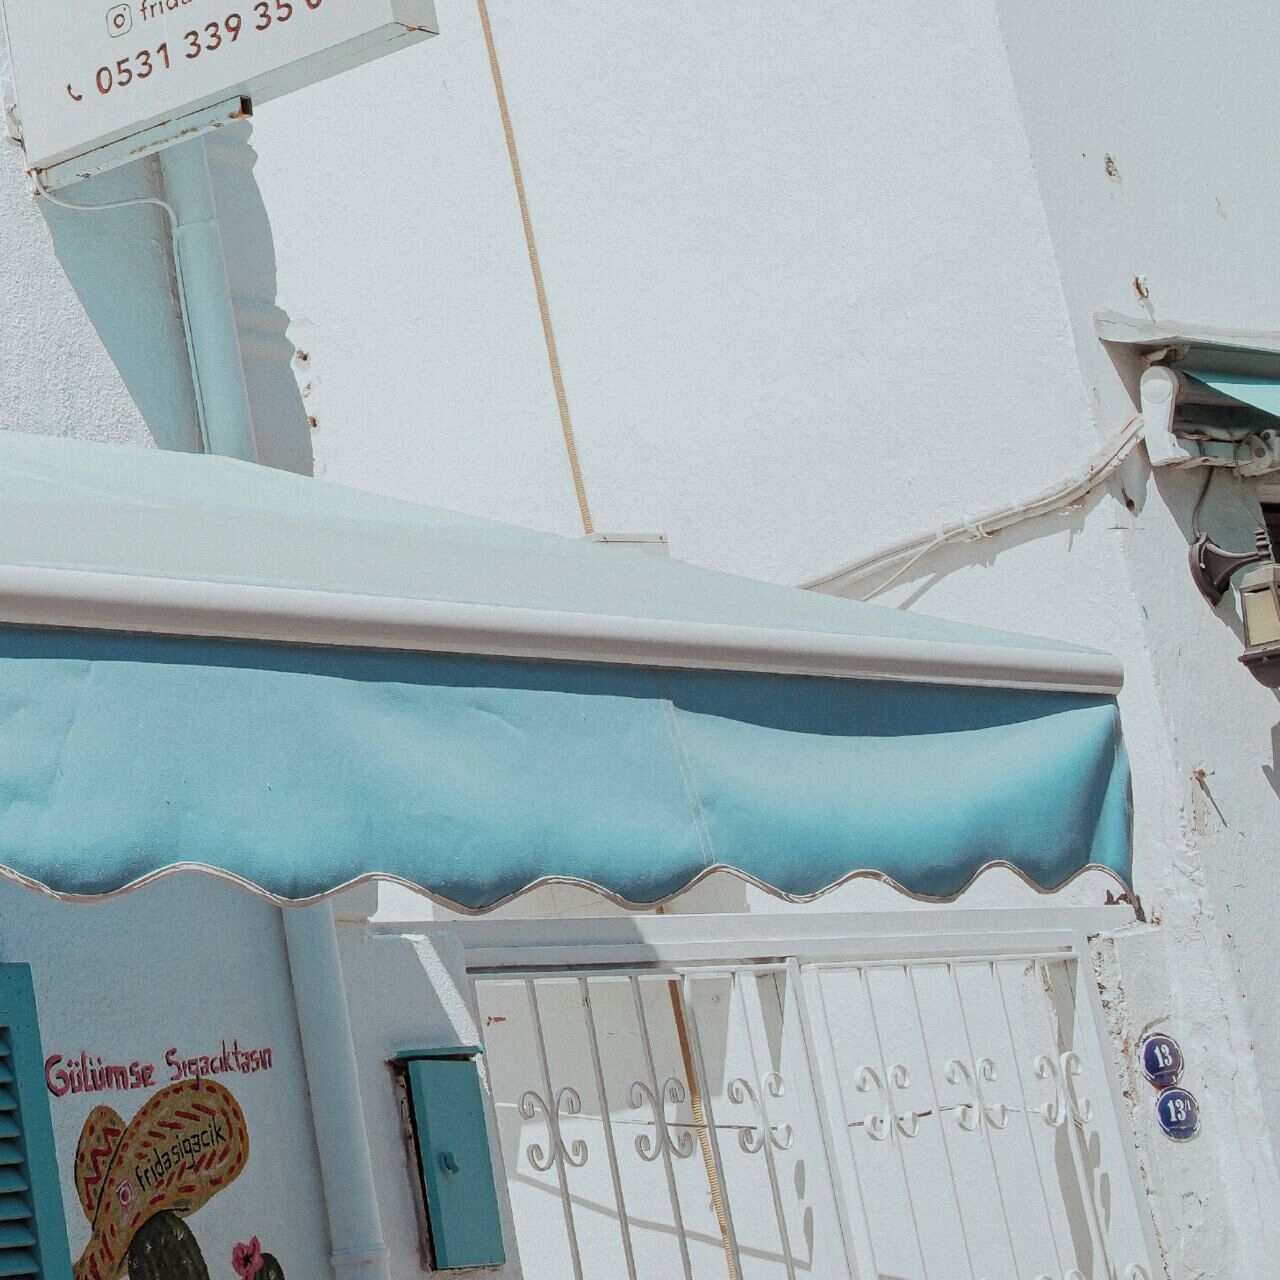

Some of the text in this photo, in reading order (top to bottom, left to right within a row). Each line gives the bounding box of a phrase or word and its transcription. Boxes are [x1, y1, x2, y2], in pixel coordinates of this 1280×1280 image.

[95, 42, 171, 95] 0531
[182, 13, 242, 60] 339
[44, 1050, 157, 1098] Gülümse
[1153, 1044, 1173, 1068] 13
[134, 1114, 227, 1193] fridasigacik
